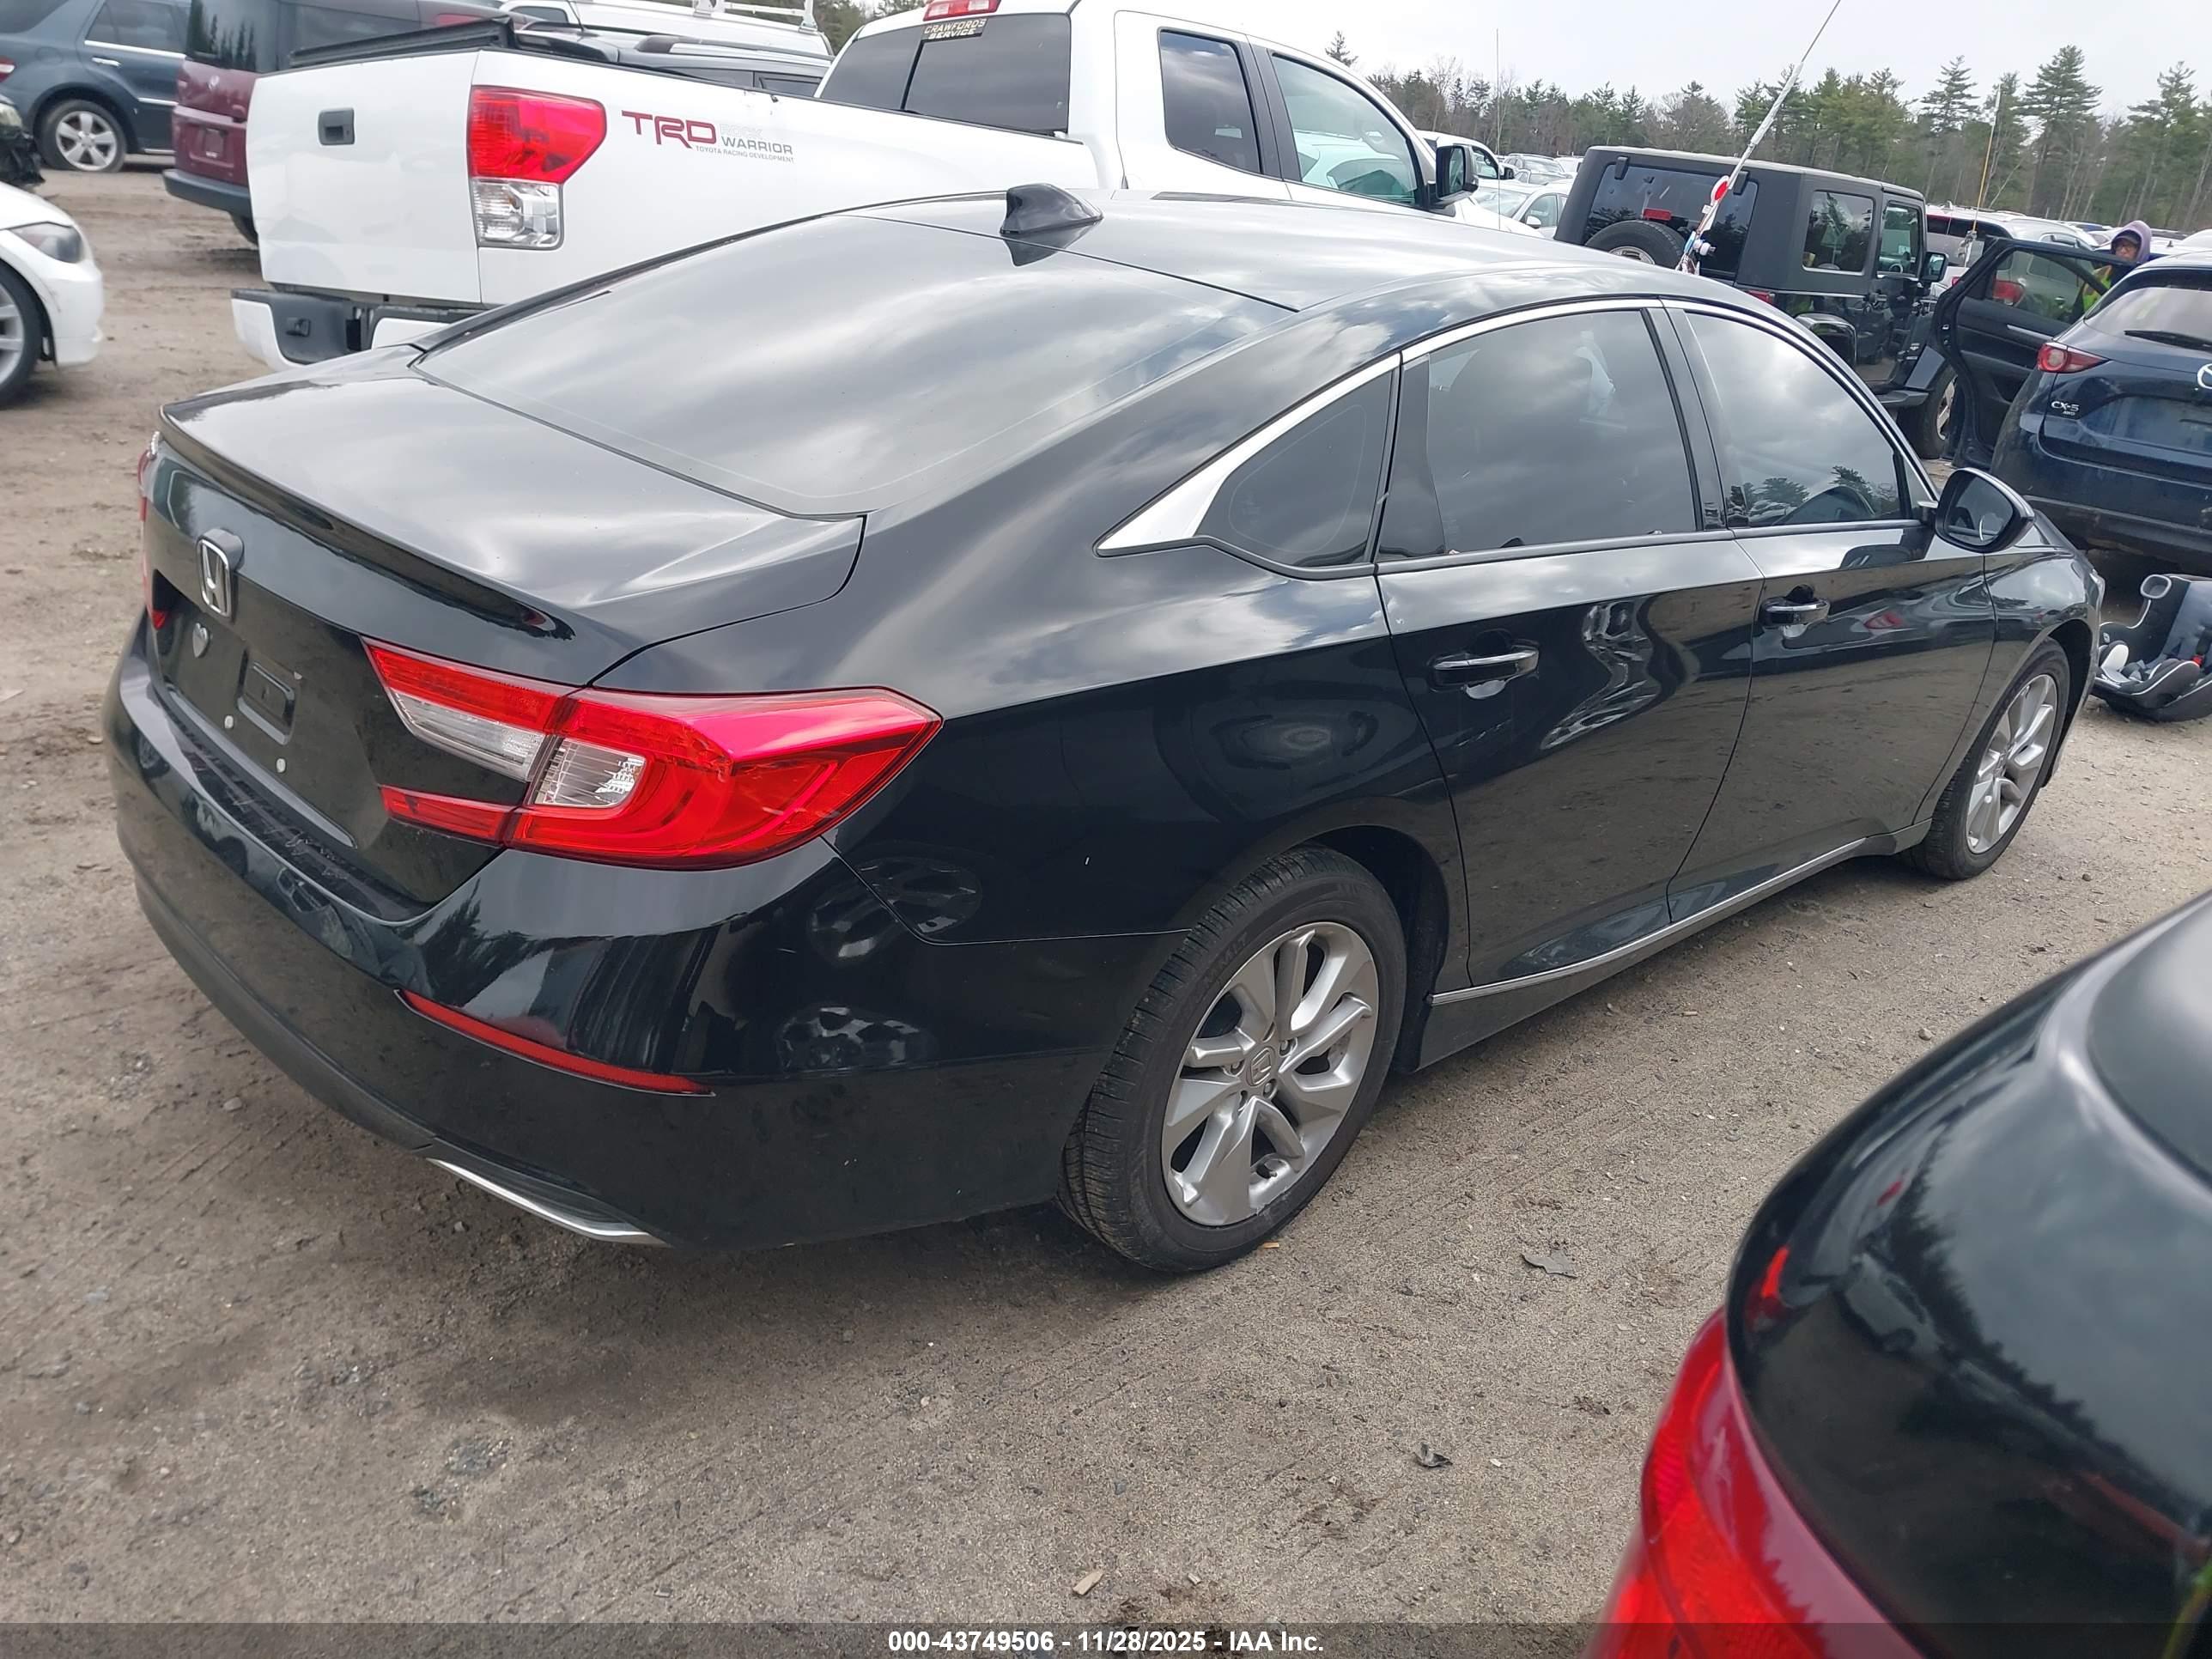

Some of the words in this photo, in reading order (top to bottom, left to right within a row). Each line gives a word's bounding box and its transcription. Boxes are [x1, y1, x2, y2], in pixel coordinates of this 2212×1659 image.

[928, 28, 976, 40] SERVICE
[621, 110, 717, 149] TRD
[696, 145, 721, 155] TOYOTA
[723, 149, 748, 158] RACING
[749, 152, 794, 163] DEVELOPMENT
[721, 136, 793, 155] WARRIOR
[2051, 401, 2079, 411] CX-5
